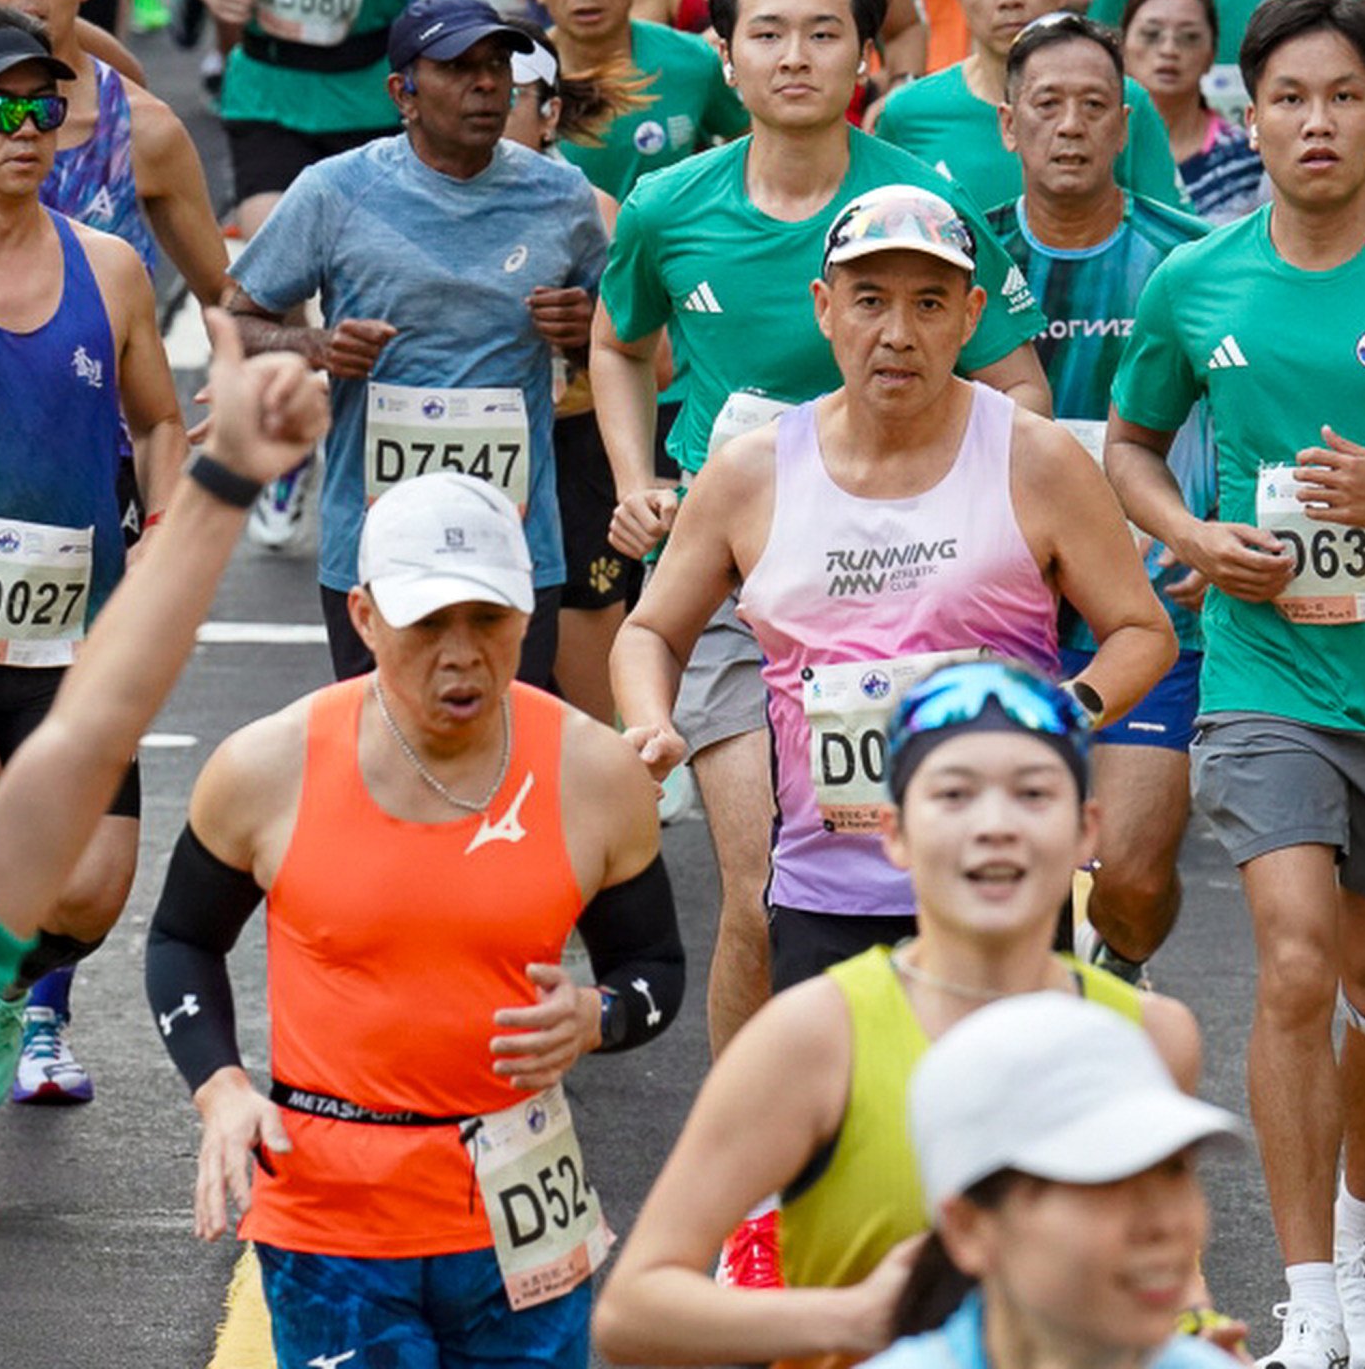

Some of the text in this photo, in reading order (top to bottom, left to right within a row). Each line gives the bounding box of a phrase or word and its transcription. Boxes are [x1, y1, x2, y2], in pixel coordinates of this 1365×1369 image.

[376, 438, 521, 488] D7547
[826, 538, 958, 573] RUNNING
[499, 1156, 591, 1248] D52
